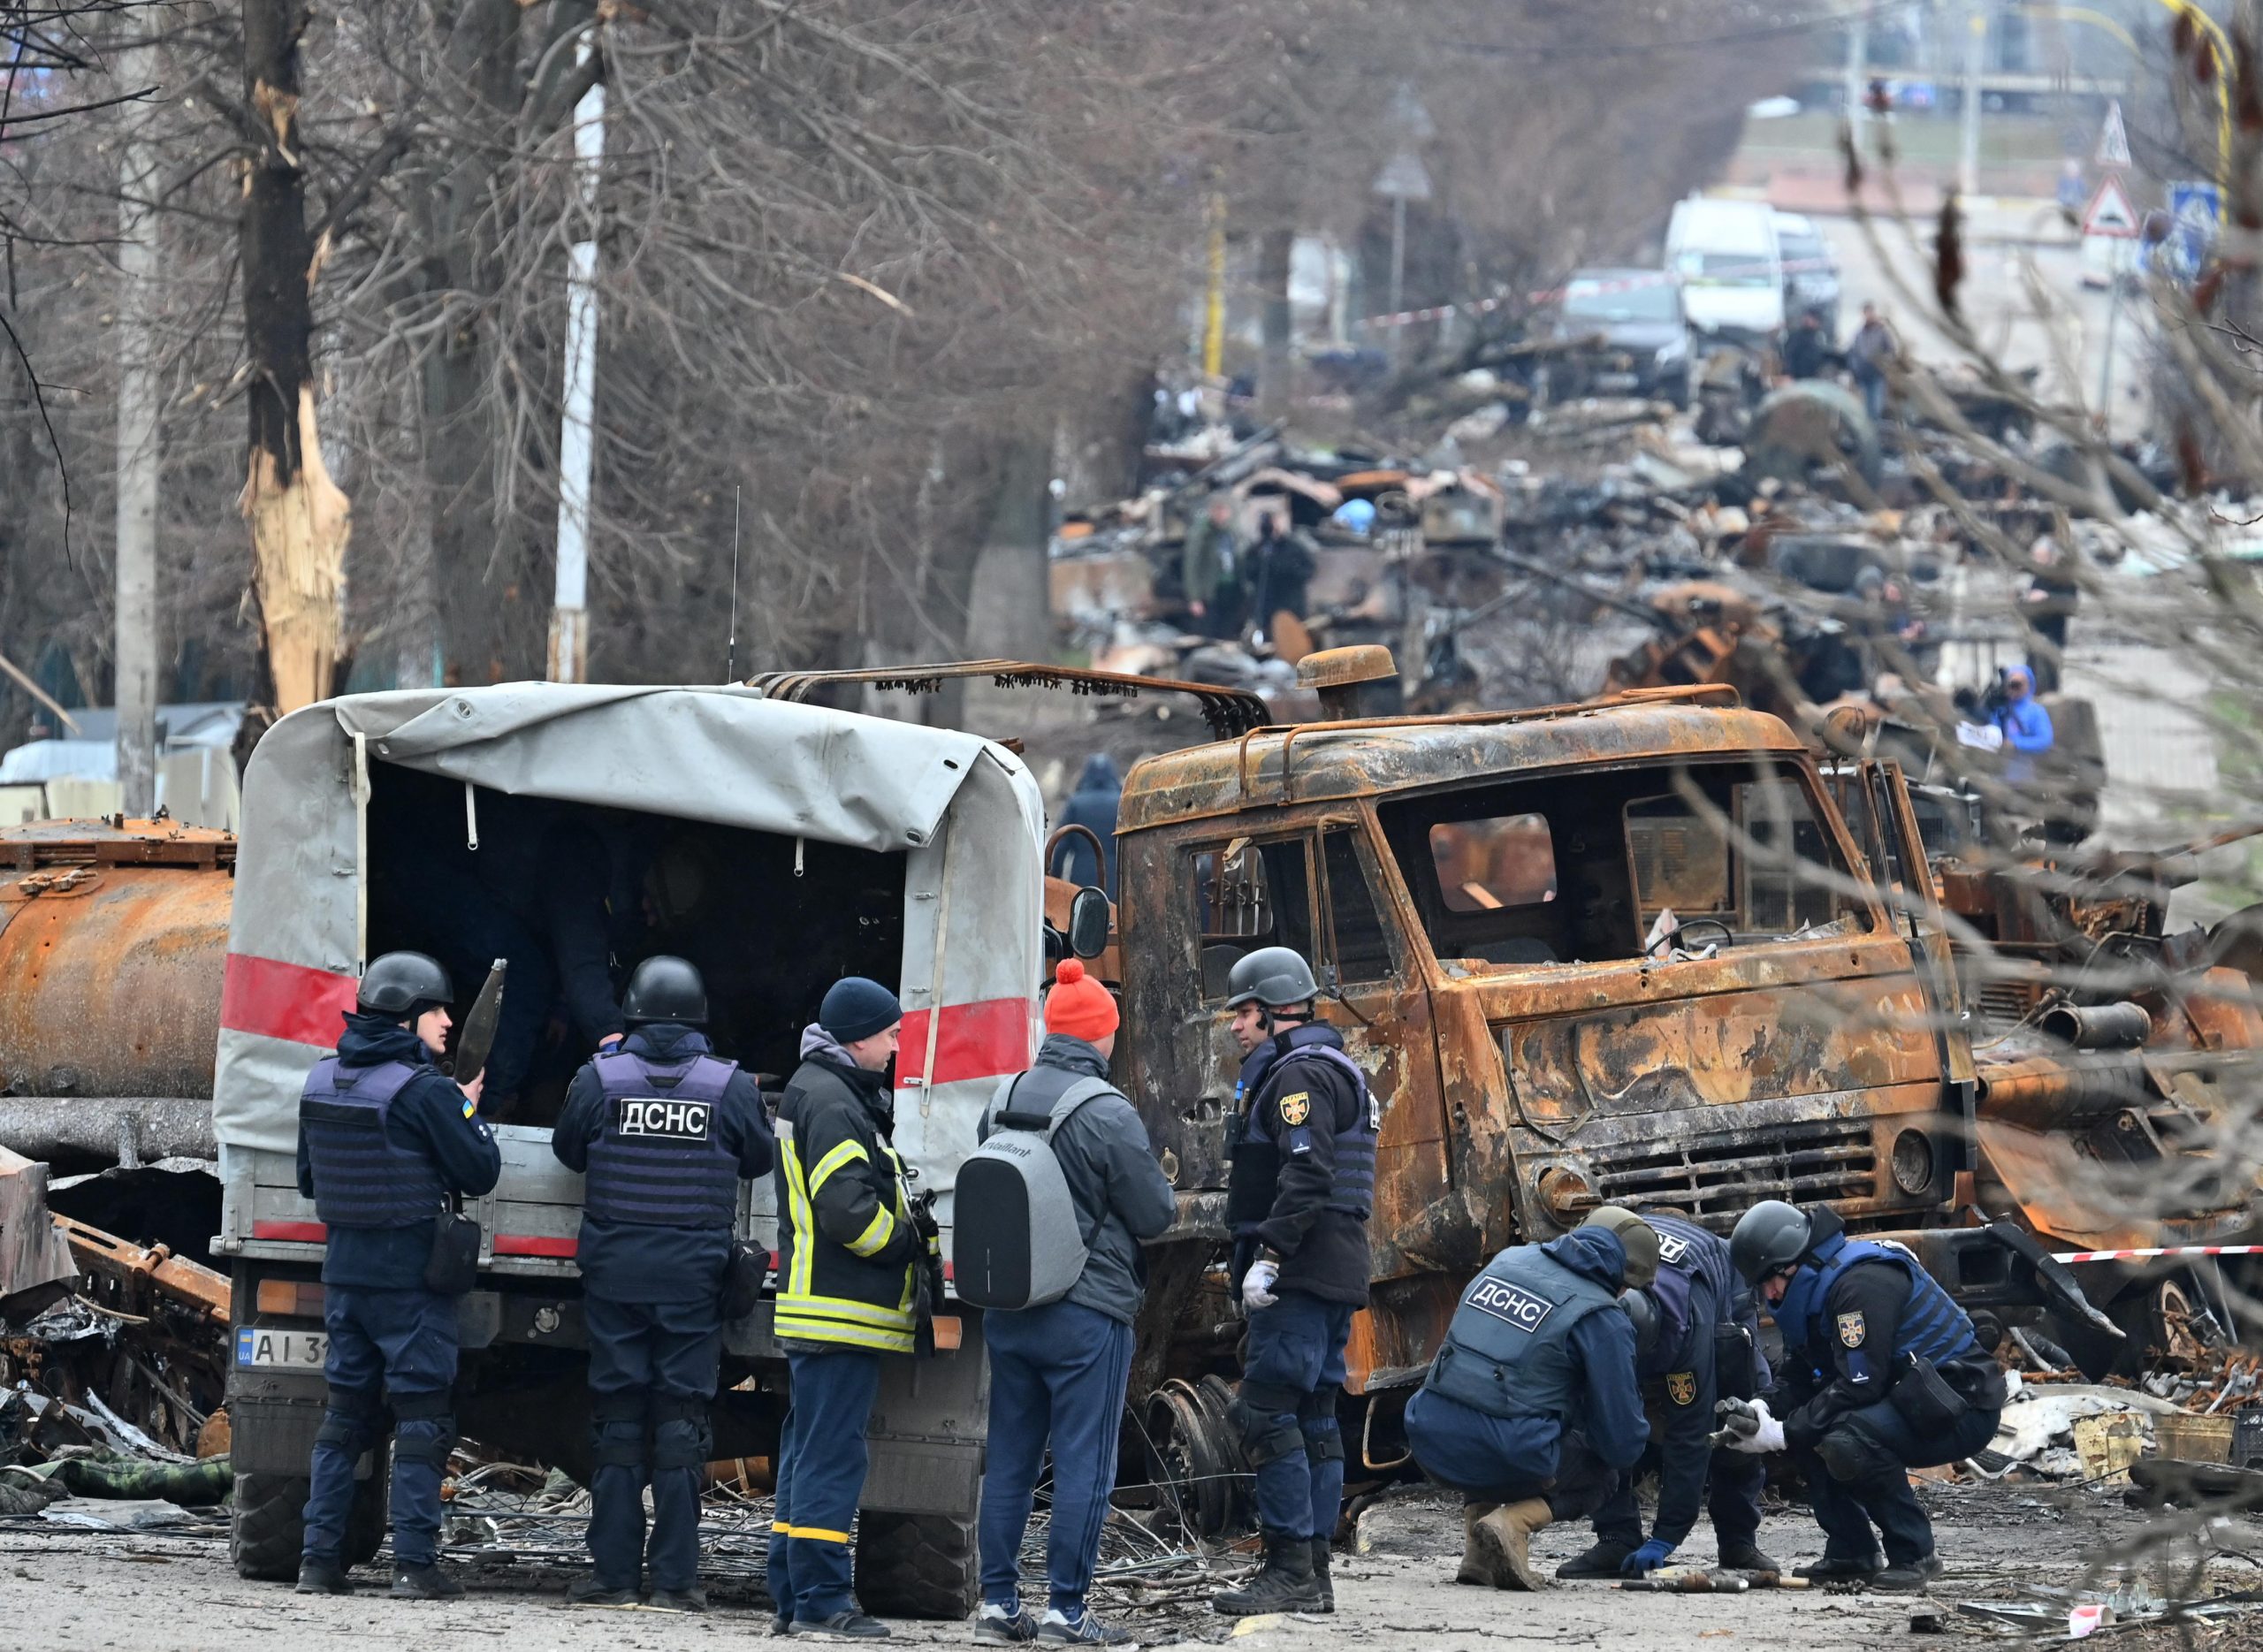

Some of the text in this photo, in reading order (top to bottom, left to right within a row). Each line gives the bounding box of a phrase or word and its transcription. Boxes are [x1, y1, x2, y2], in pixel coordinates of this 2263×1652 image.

[622, 1102, 705, 1134] ДСНС
[1473, 1283, 1541, 1322] ДСНС
[238, 1351, 251, 1360] UA
